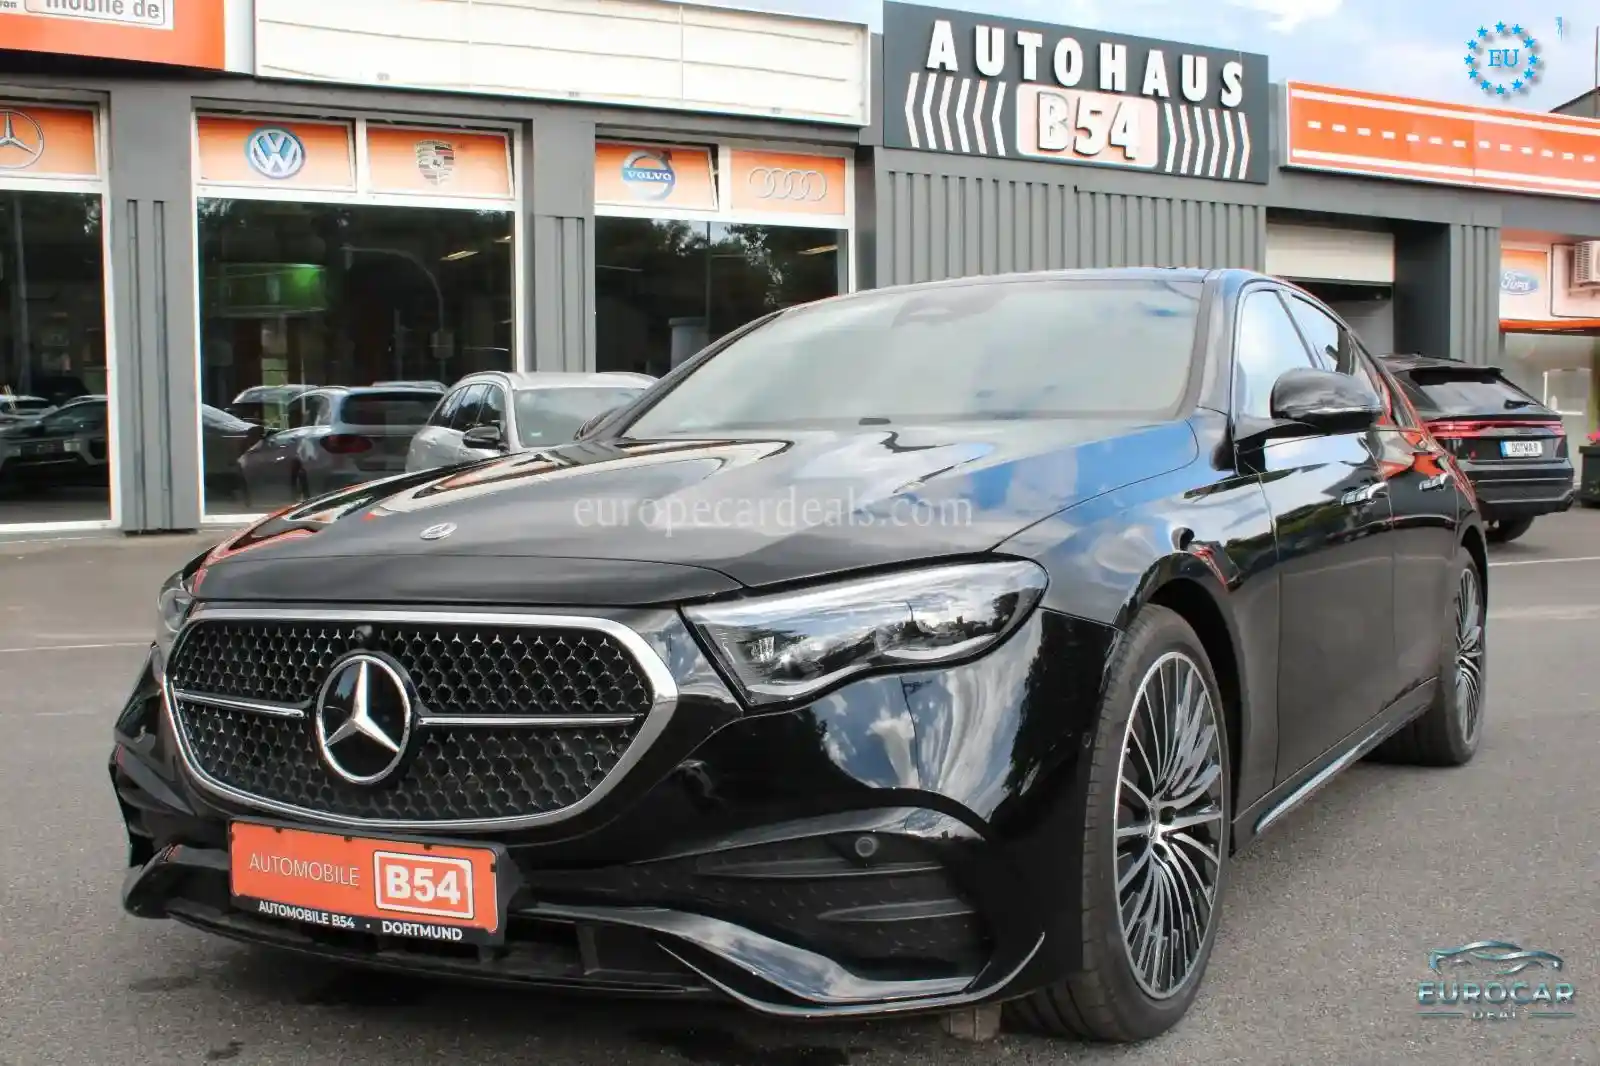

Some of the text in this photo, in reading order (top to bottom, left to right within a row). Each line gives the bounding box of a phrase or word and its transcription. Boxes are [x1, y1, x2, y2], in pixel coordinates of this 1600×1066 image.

[926, 19, 1244, 108] AUTOHAUS
[1036, 91, 1139, 161] B54
[626, 169, 673, 182] VOLVO
[249, 852, 461, 904] AUTOMOBILE B54
[258, 900, 463, 941] AUTOMOBILE B54 DORTMUND
